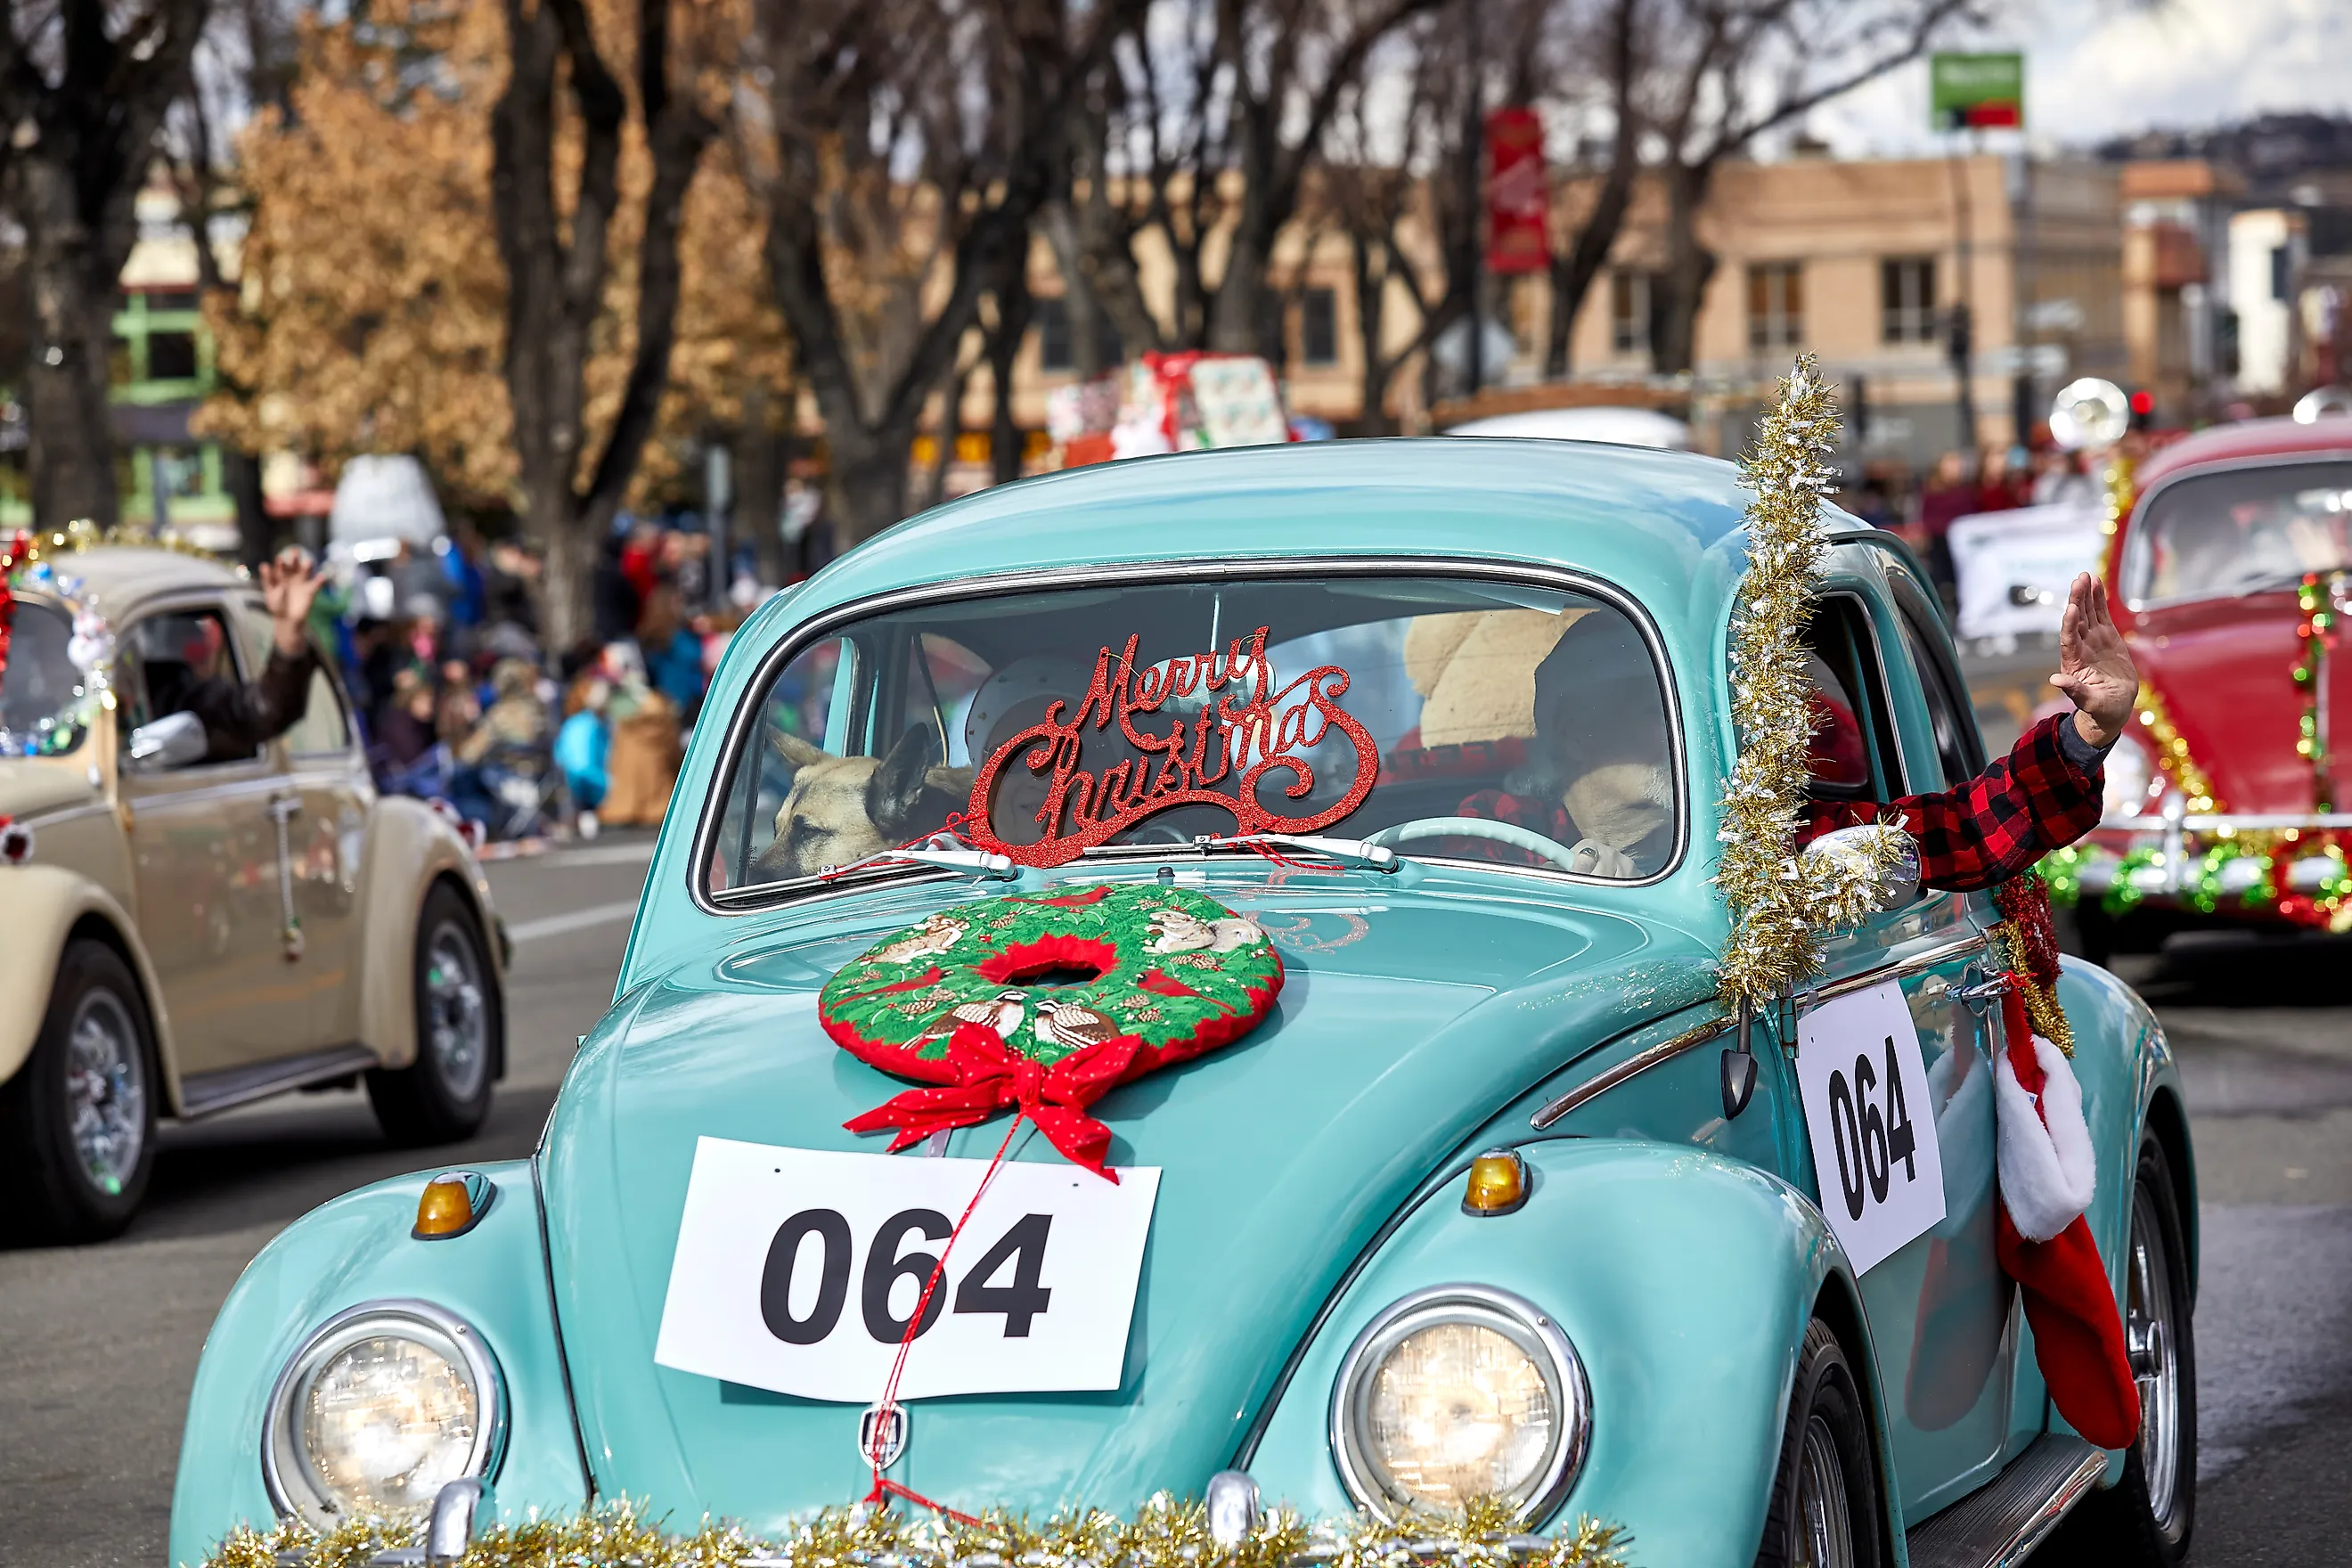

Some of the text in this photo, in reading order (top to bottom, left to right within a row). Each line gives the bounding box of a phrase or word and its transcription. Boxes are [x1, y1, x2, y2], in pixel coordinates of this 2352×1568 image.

[1070, 625, 1270, 730] Merry
[968, 665, 1379, 868] Christmas
[1829, 1035, 1915, 1221] 064
[760, 1208, 1053, 1345] 064
